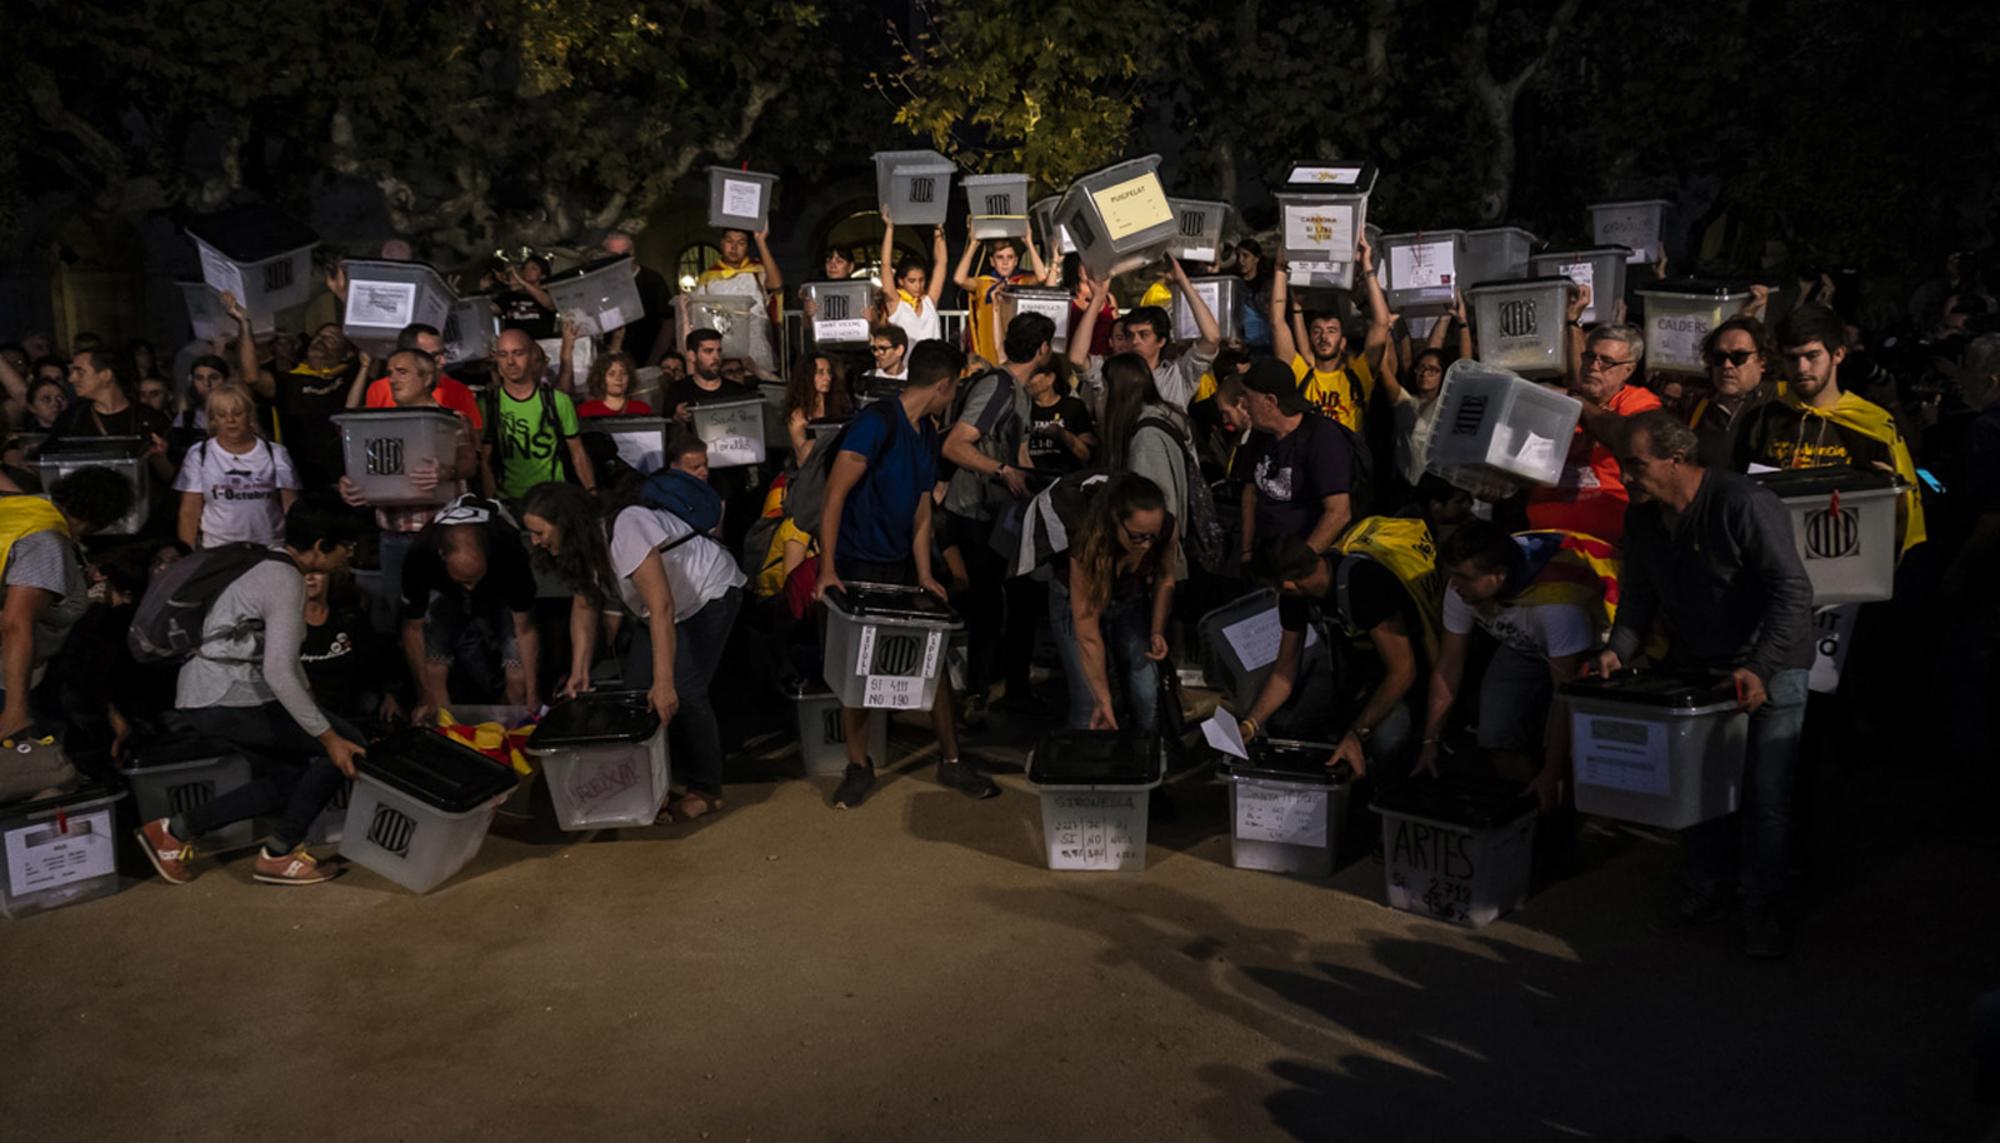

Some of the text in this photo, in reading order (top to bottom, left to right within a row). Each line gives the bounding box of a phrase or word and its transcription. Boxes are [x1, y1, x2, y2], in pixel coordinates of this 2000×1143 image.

[1657, 318, 1708, 334] CALDERS
[868, 695, 885, 705] NO
[1392, 820, 1475, 881] ARTES
